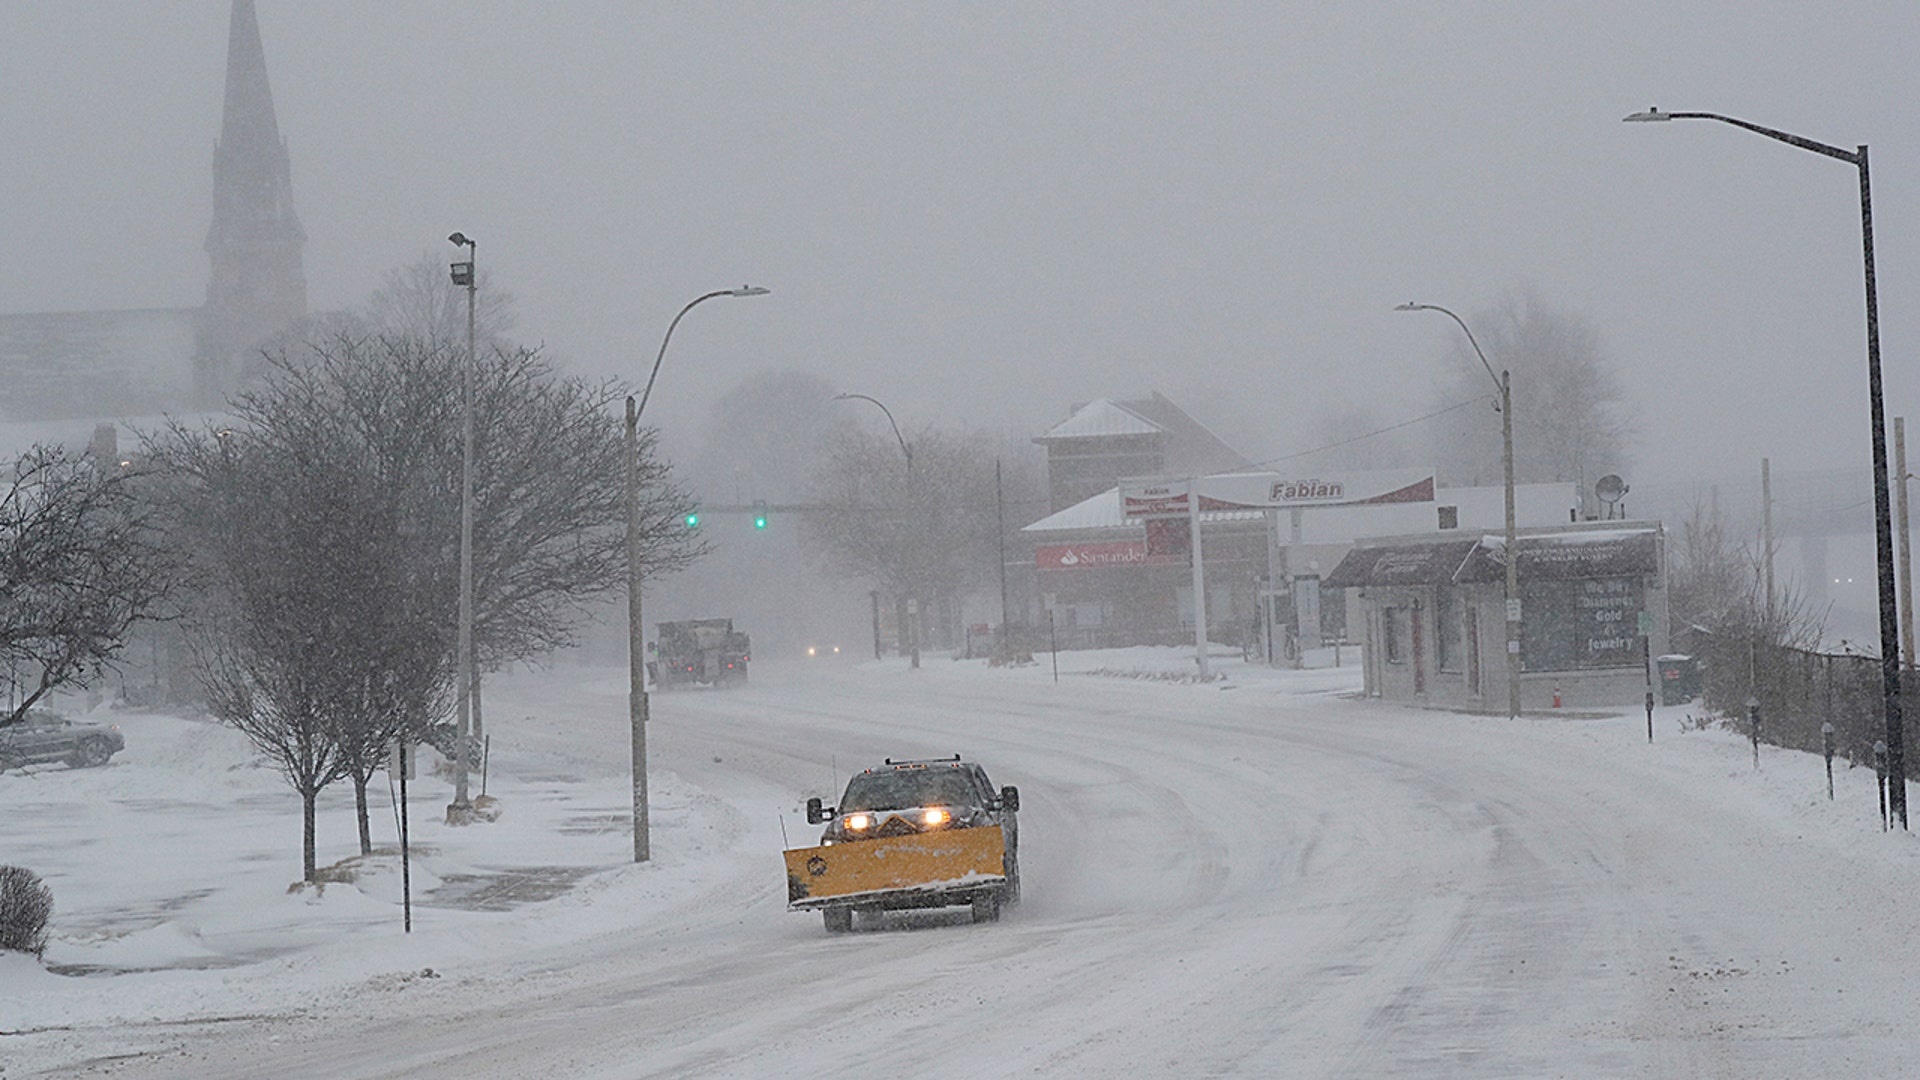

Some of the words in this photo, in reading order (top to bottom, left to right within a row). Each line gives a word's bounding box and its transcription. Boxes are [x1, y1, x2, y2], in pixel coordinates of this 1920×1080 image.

[1271, 480, 1343, 500] Fabian
[1081, 548, 1145, 564] Santander
[1595, 610, 1622, 622] Gold
[1588, 637, 1633, 652] Jewelry
